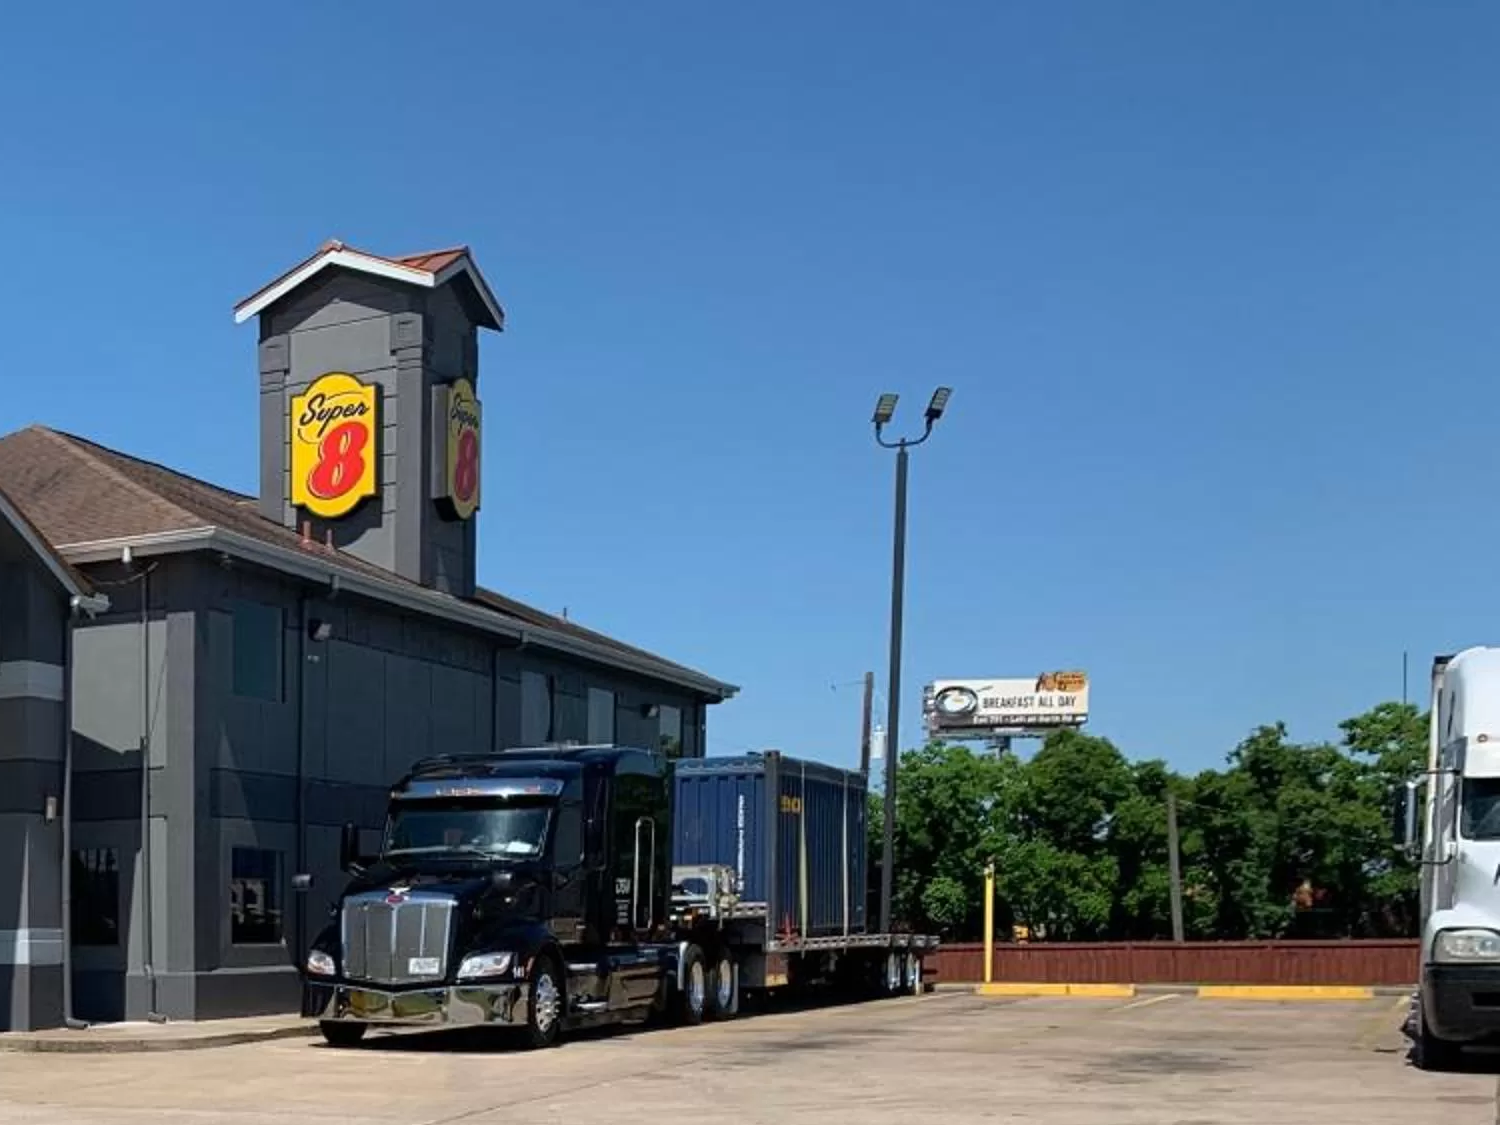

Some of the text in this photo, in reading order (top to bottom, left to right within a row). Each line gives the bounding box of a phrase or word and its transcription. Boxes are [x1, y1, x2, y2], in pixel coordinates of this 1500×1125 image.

[300, 393, 369, 438] Super
[307, 421, 368, 500] 8
[455, 428, 477, 502] 8
[983, 695, 1076, 709] BREAKFAST ALL DAY
